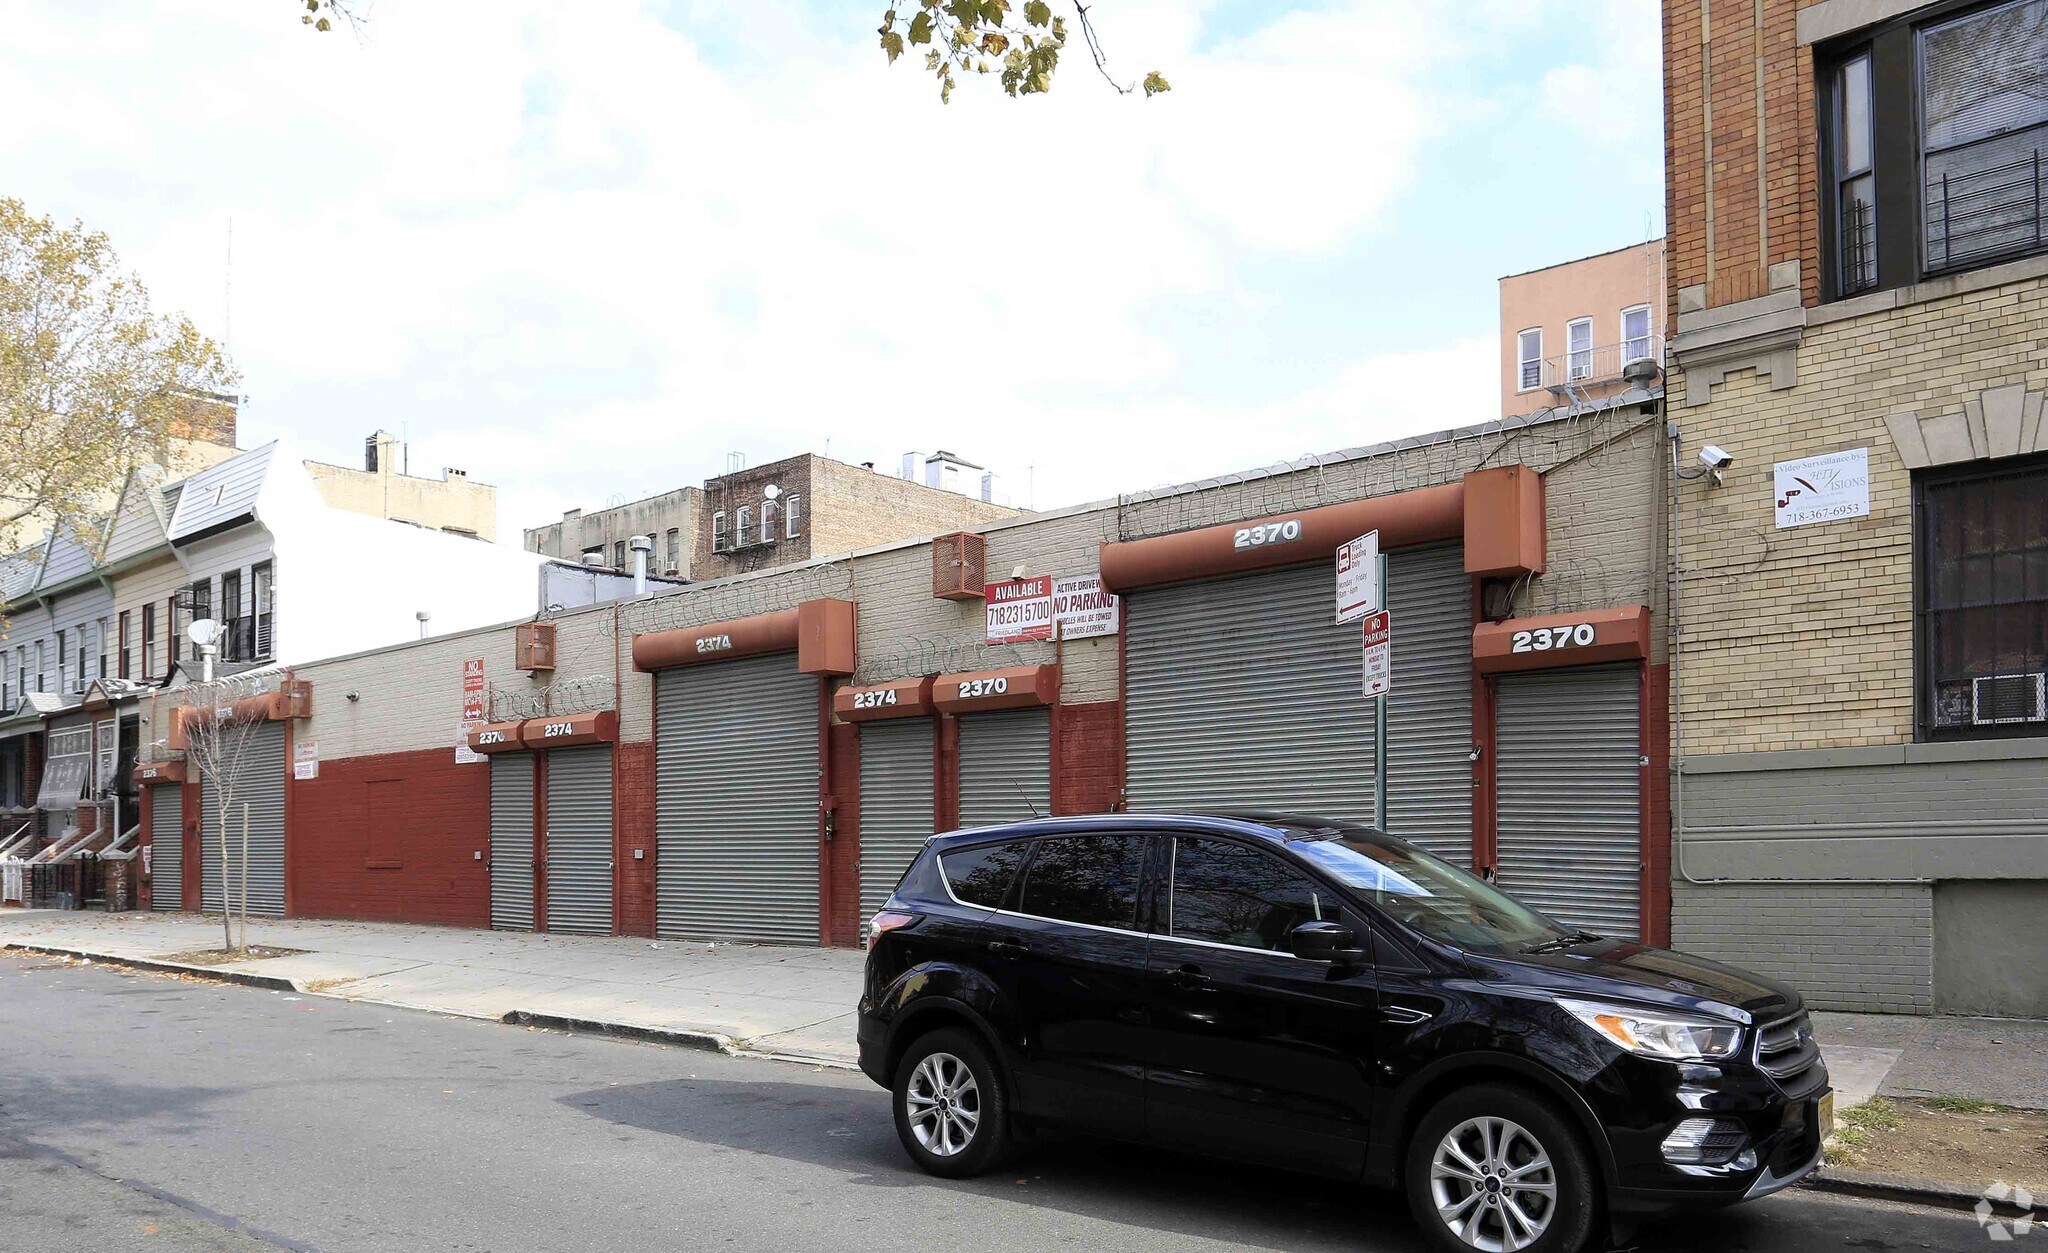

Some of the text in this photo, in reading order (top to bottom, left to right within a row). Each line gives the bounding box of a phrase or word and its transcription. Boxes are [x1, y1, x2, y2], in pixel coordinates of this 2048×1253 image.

[1779, 464, 1801, 473] Video
[1802, 456, 1850, 469] Surveillance
[1786, 503, 1859, 523] 718-367-6953
[1234, 520, 1299, 548] 2370
[1351, 549, 1366, 560] Loading
[1351, 560, 1361, 569] Only
[1057, 579, 1100, 593] ACTIVE DRIVEW
[1339, 579, 1352, 589] Monday
[1356, 573, 1367, 583] Friday
[995, 580, 1043, 600] AVAILABLE
[1053, 592, 1114, 614] NO PARKING
[1088, 614, 1095, 622] BE
[1096, 611, 1111, 621] TOWED
[1371, 618, 1381, 631] NO
[1086, 623, 1107, 633] EXPENSE
[696, 635, 732, 653] 2374
[1364, 629, 1388, 646] PARKING
[1512, 623, 1594, 653] 2370
[469, 661, 479, 671] NO
[959, 677, 1007, 698] 2370
[854, 689, 896, 709] 2374
[544, 722, 572, 737] 2374
